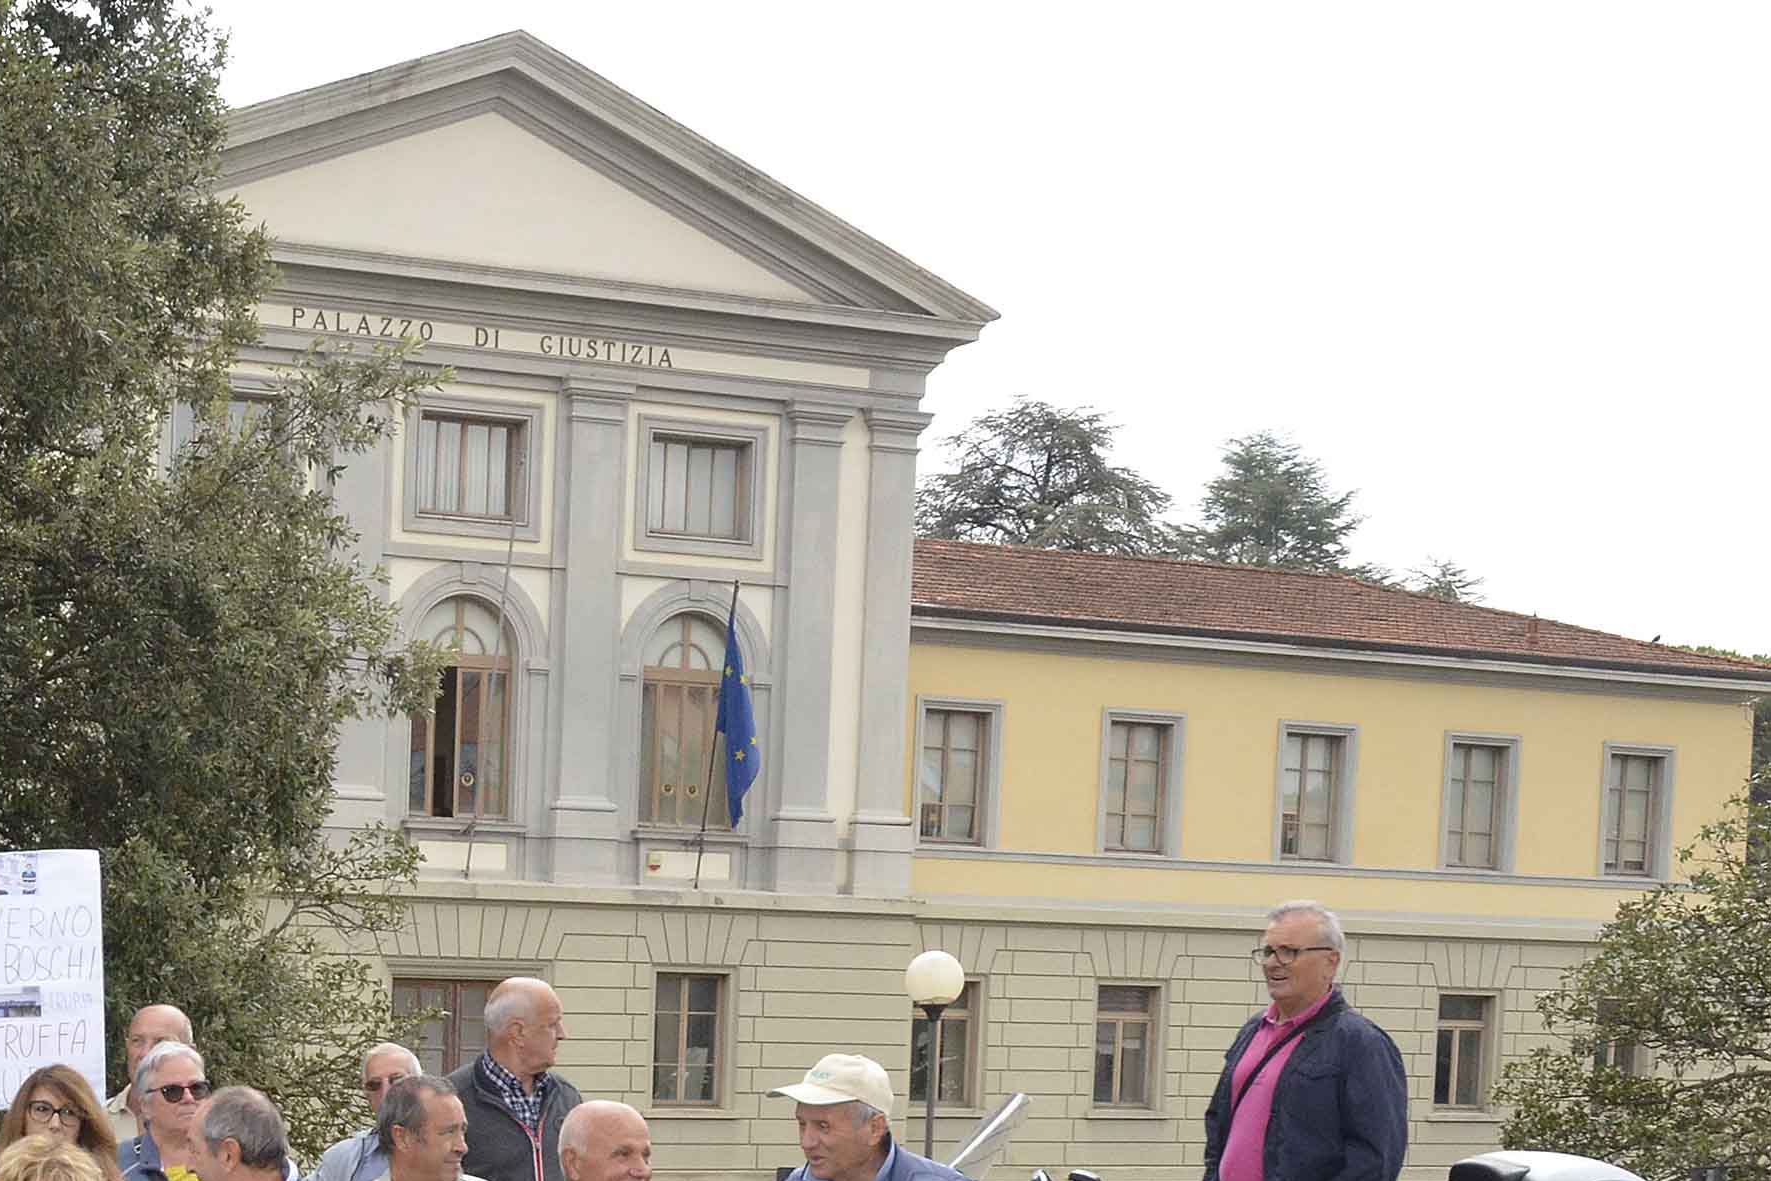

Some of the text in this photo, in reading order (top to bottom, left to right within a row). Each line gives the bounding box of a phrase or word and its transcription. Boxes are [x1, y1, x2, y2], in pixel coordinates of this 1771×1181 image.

[291, 307, 674, 368] PALAZZO DI GIUSTIZIA
[4, 943, 95, 985] BOSCHI
